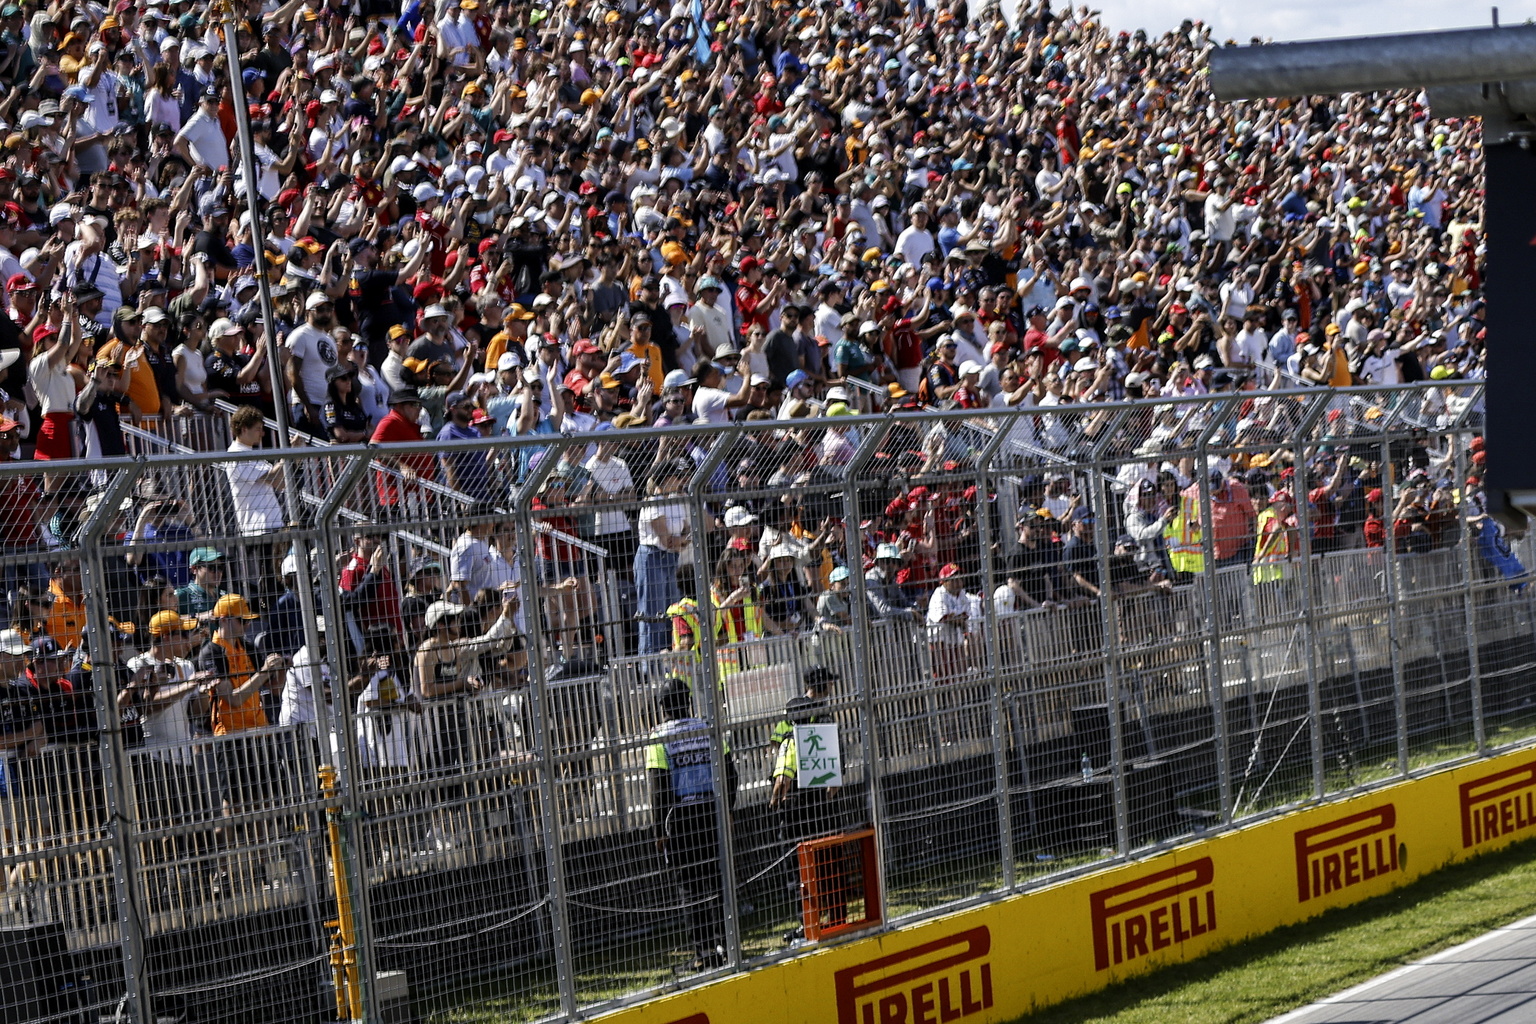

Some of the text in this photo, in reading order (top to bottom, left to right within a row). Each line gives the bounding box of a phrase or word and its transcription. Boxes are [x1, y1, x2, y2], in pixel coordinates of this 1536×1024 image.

[799, 756, 838, 772] EXIT
[1294, 803, 1399, 903] PIRELLI
[1090, 856, 1217, 972] PIRELLI
